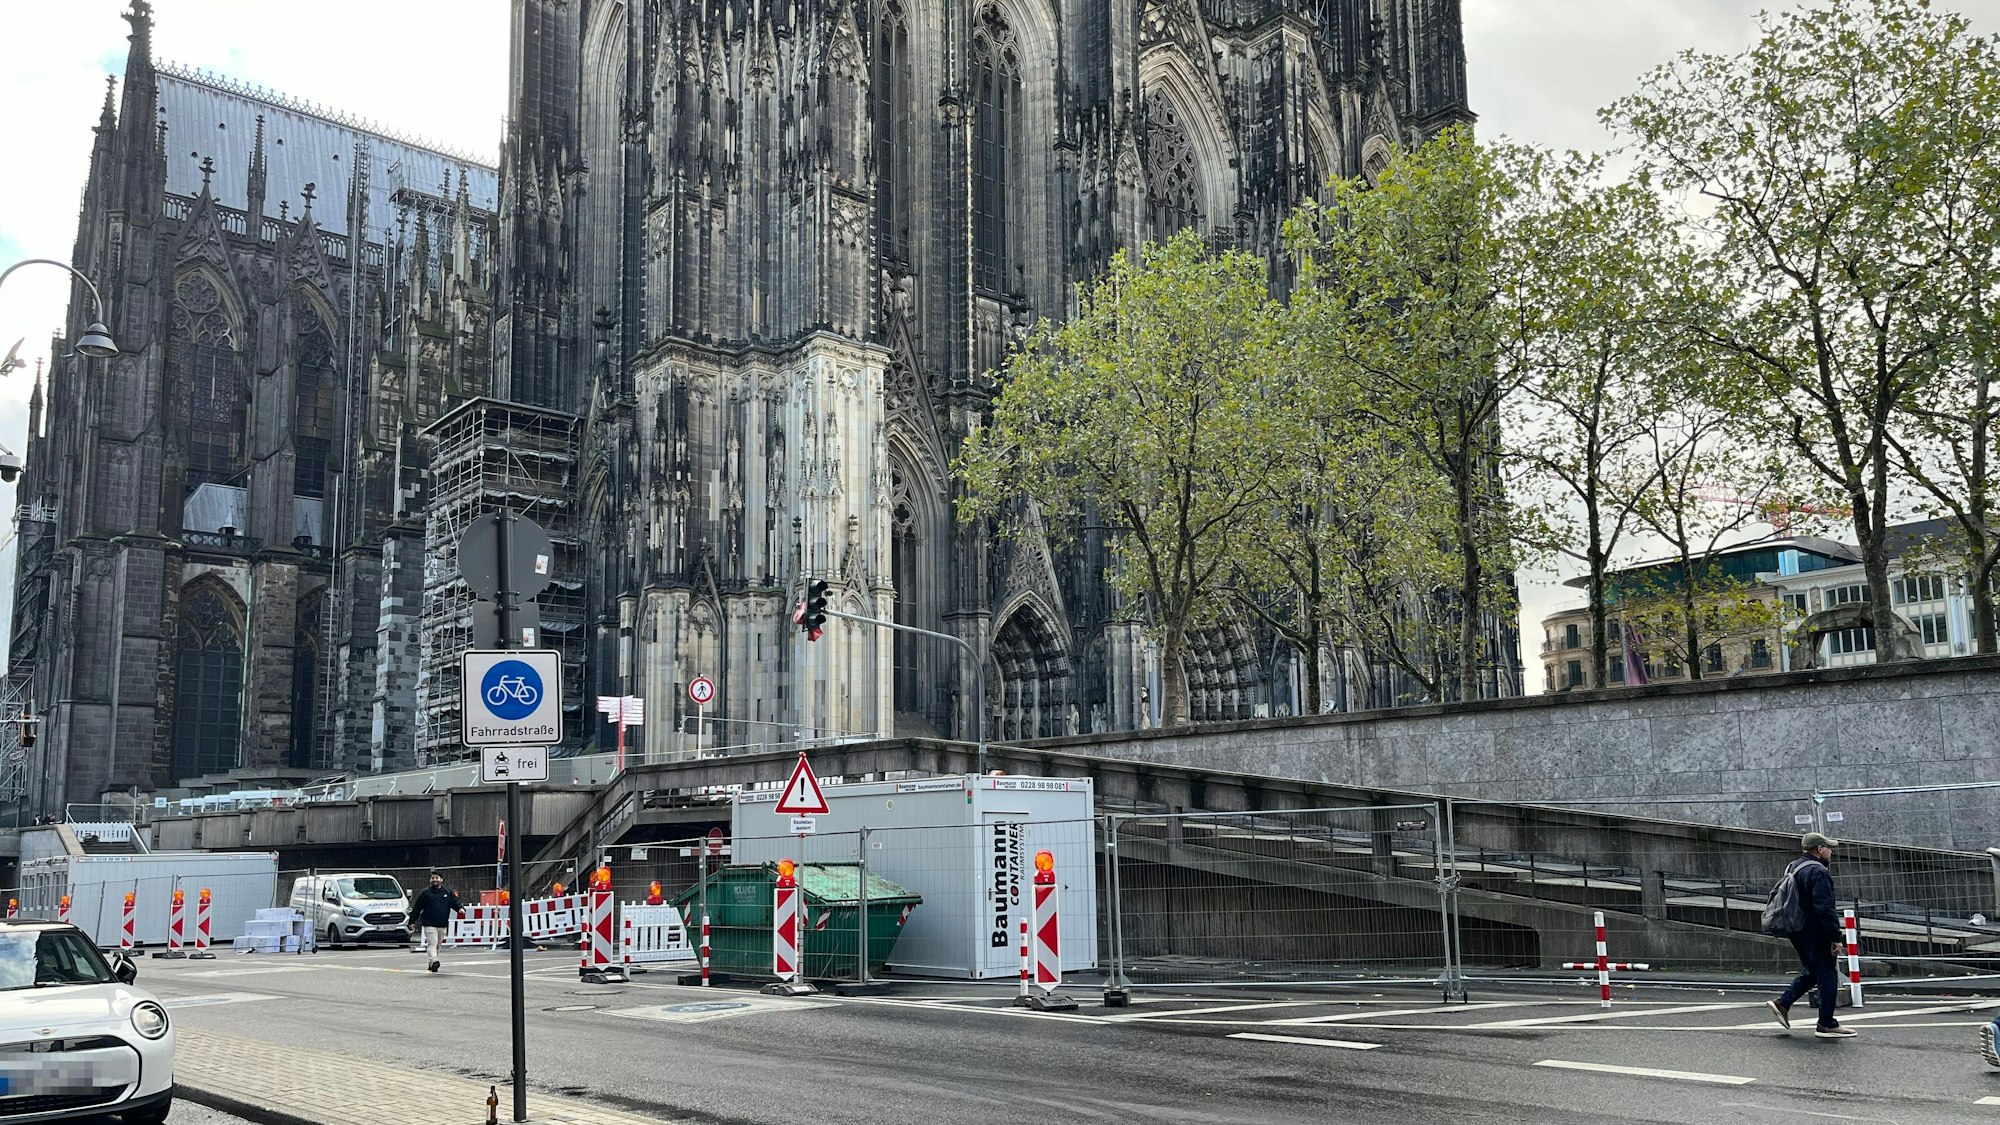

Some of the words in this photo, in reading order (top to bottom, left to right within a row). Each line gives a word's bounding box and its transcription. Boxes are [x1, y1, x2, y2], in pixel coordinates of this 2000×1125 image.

[471, 725, 554, 737] Fahrradstraße
[517, 758, 537, 768] frei
[917, 782, 961, 790] baumanncontainer.de
[1020, 781, 1036, 789] 0228
[1054, 782, 1065, 790] 081
[756, 792, 768, 801] 0228
[768, 792, 774, 800] 98
[1009, 822, 1019, 906] CONTAINER
[991, 820, 1008, 947] Baumann
